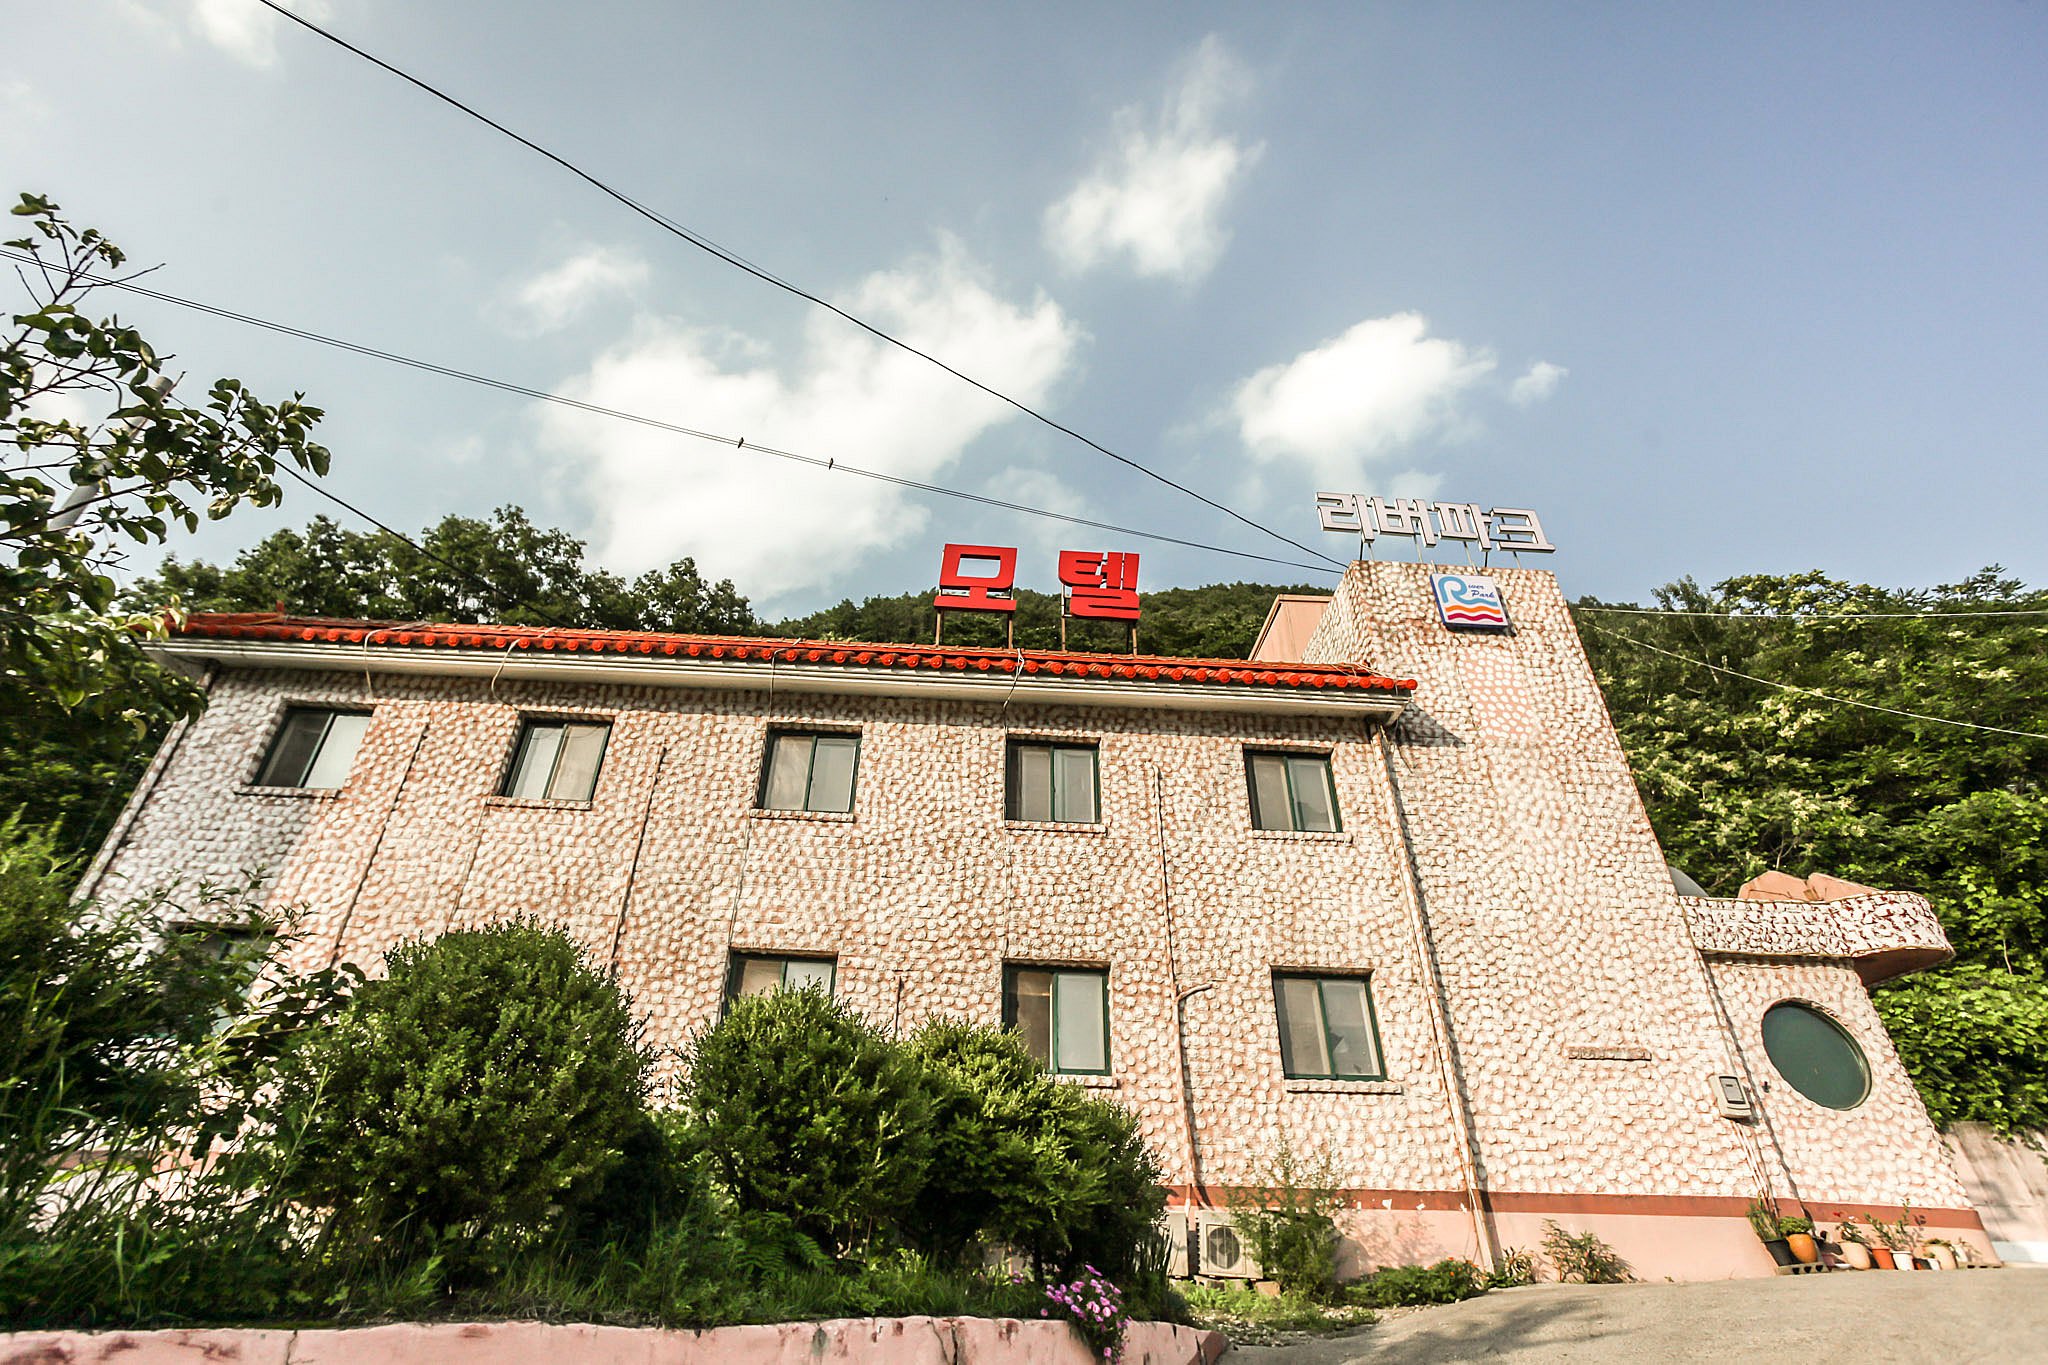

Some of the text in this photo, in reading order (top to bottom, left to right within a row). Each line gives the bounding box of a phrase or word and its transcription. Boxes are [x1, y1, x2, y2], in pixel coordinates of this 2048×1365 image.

[1315, 492, 1556, 553] 리버파크
[934, 544, 1141, 620] 모텔
[1471, 590, 1495, 598] Park
